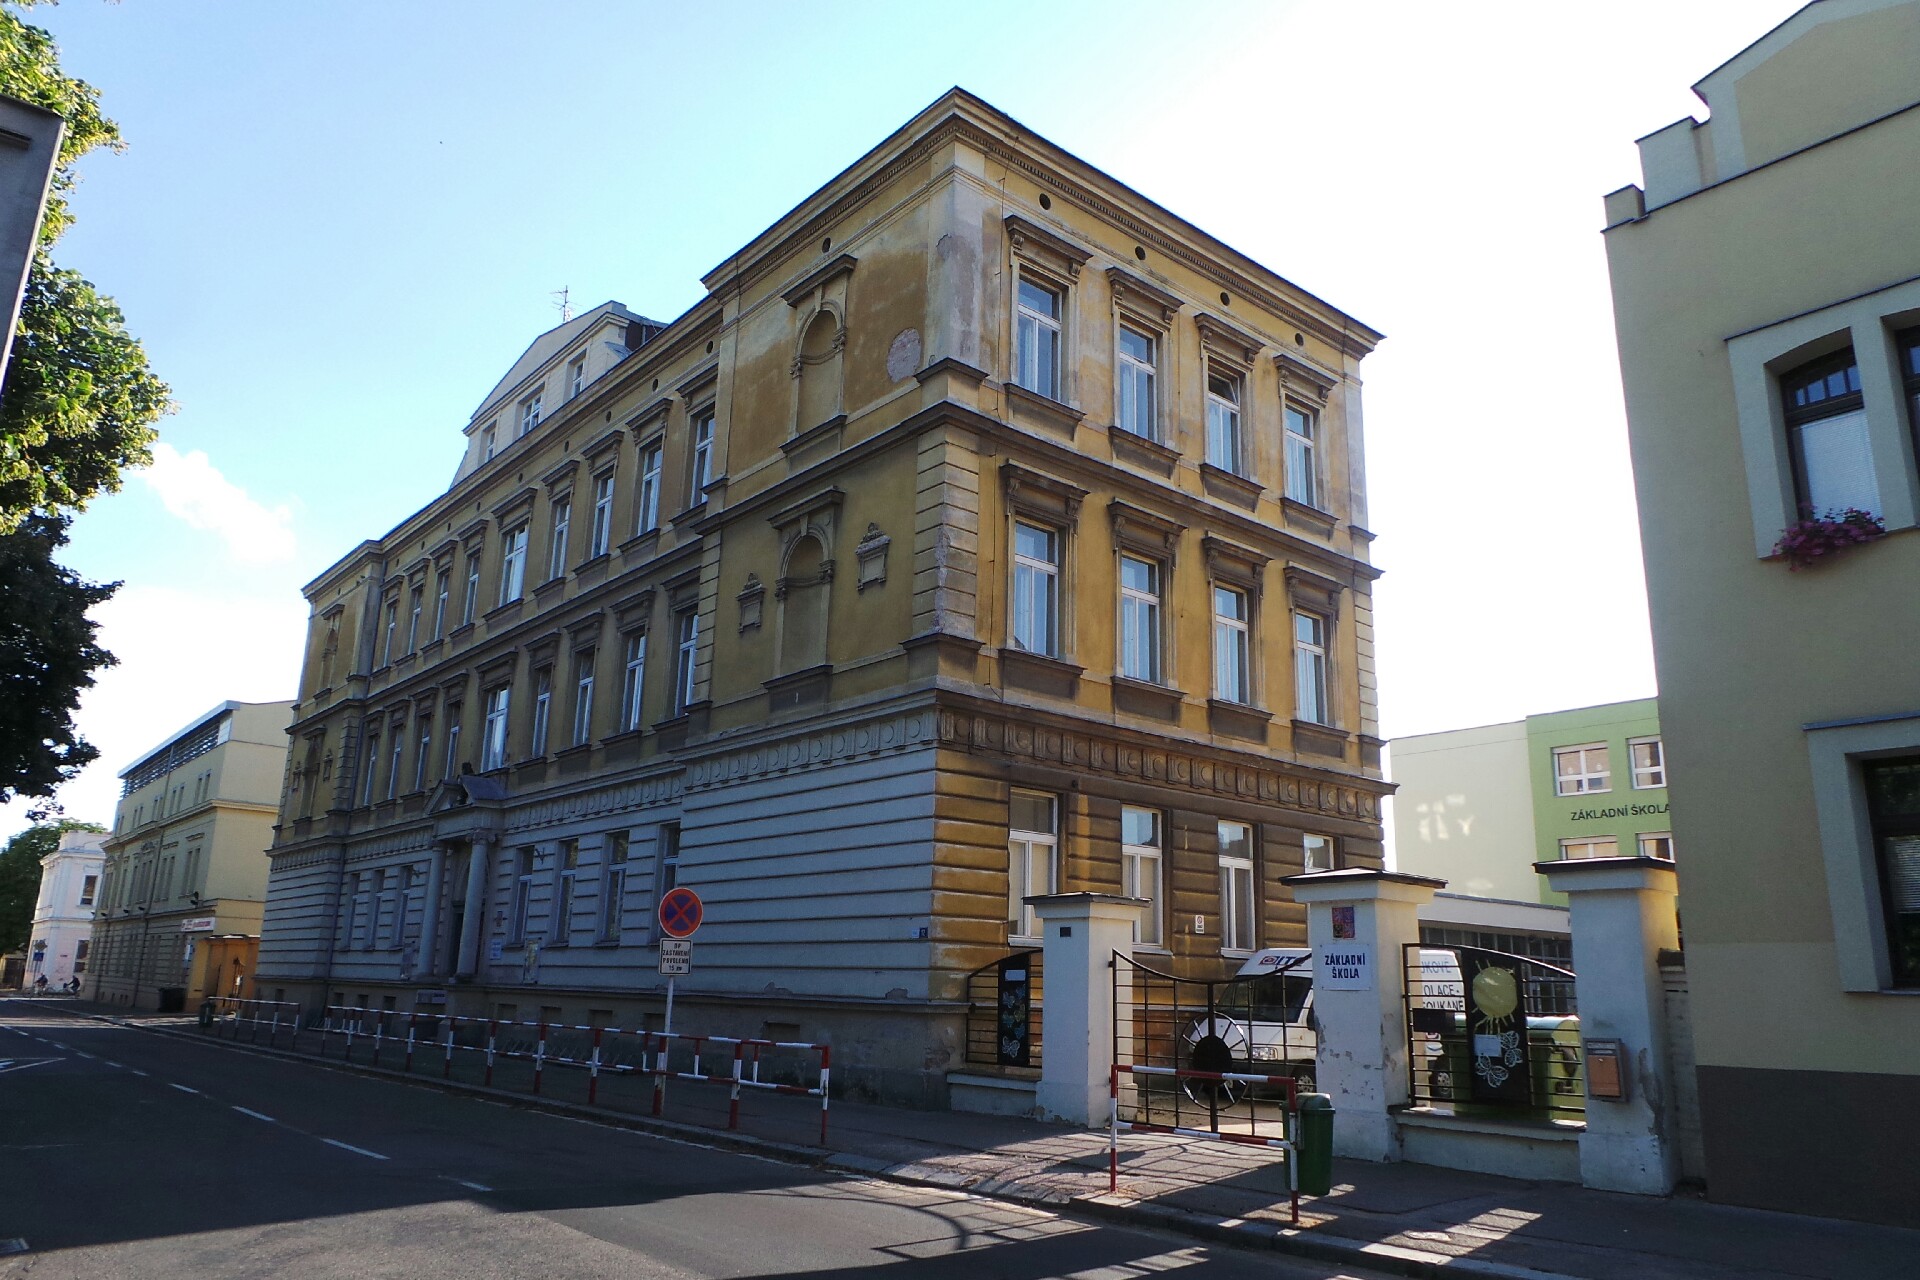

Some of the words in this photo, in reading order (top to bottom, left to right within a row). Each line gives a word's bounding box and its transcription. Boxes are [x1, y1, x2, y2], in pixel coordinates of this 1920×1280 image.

[1571, 804, 1628, 820] ZÁKLADNÍ
[1631, 803, 1670, 816] ŠKOLA
[1324, 952, 1365, 966] ZÁKLADNÍ
[1332, 966, 1360, 979] ŠKOLA
